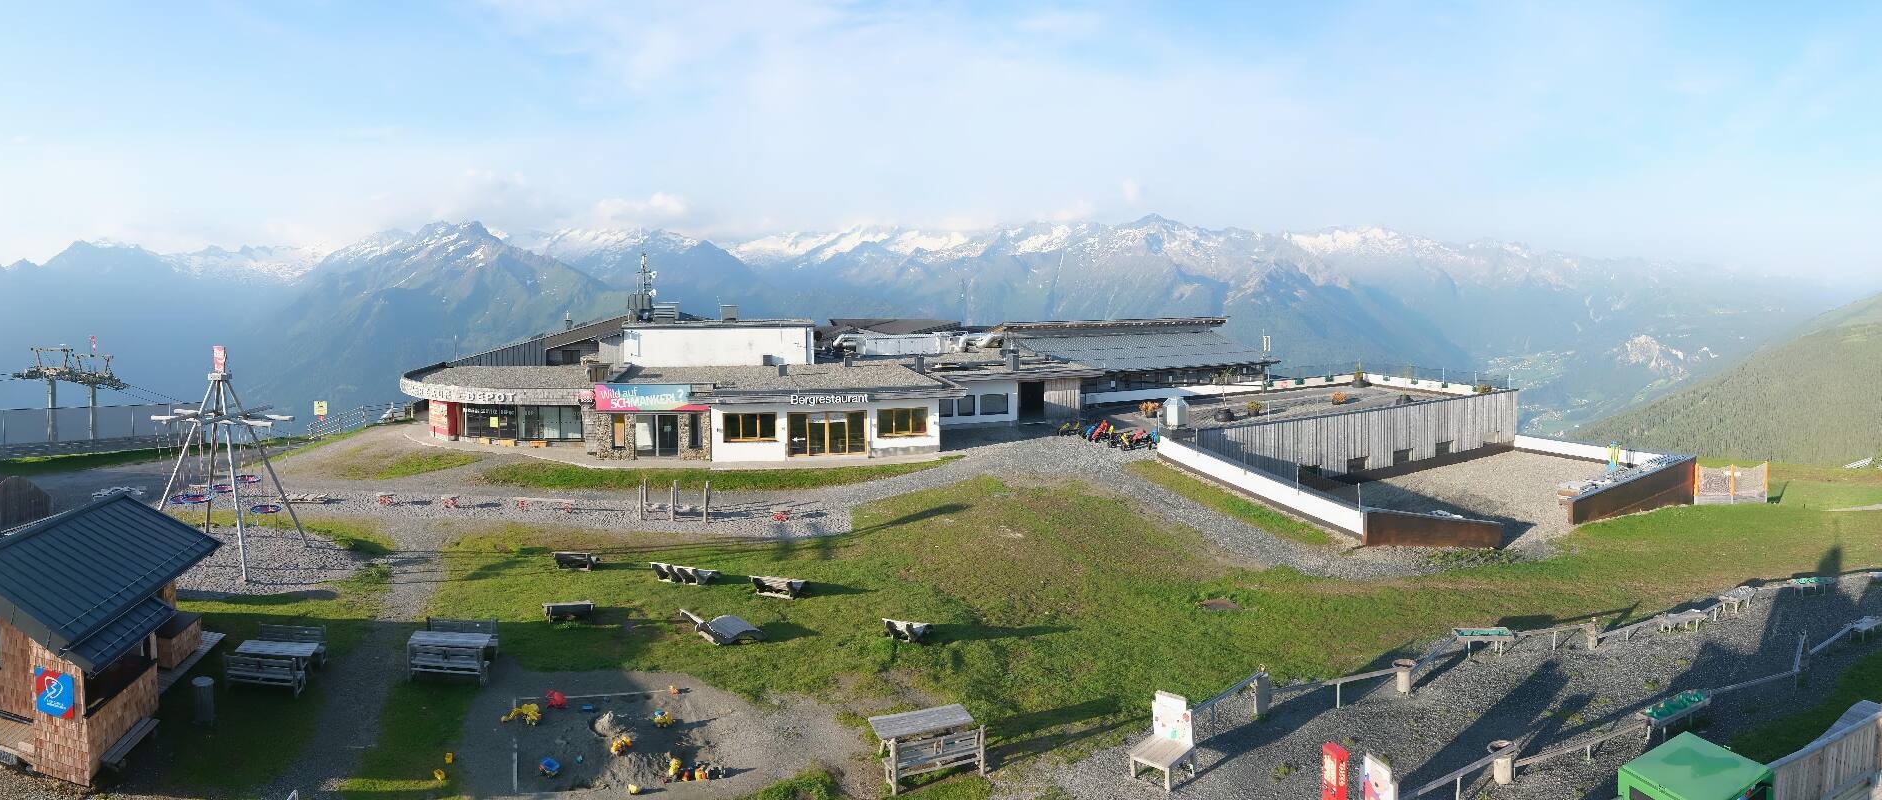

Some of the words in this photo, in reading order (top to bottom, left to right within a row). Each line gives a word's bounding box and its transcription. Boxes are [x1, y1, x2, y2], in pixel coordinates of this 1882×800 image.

[466, 391, 516, 402] DEPOT
[601, 388, 620, 400] Wild
[622, 386, 638, 397] auf
[790, 393, 869, 406] Bergrestaurant
